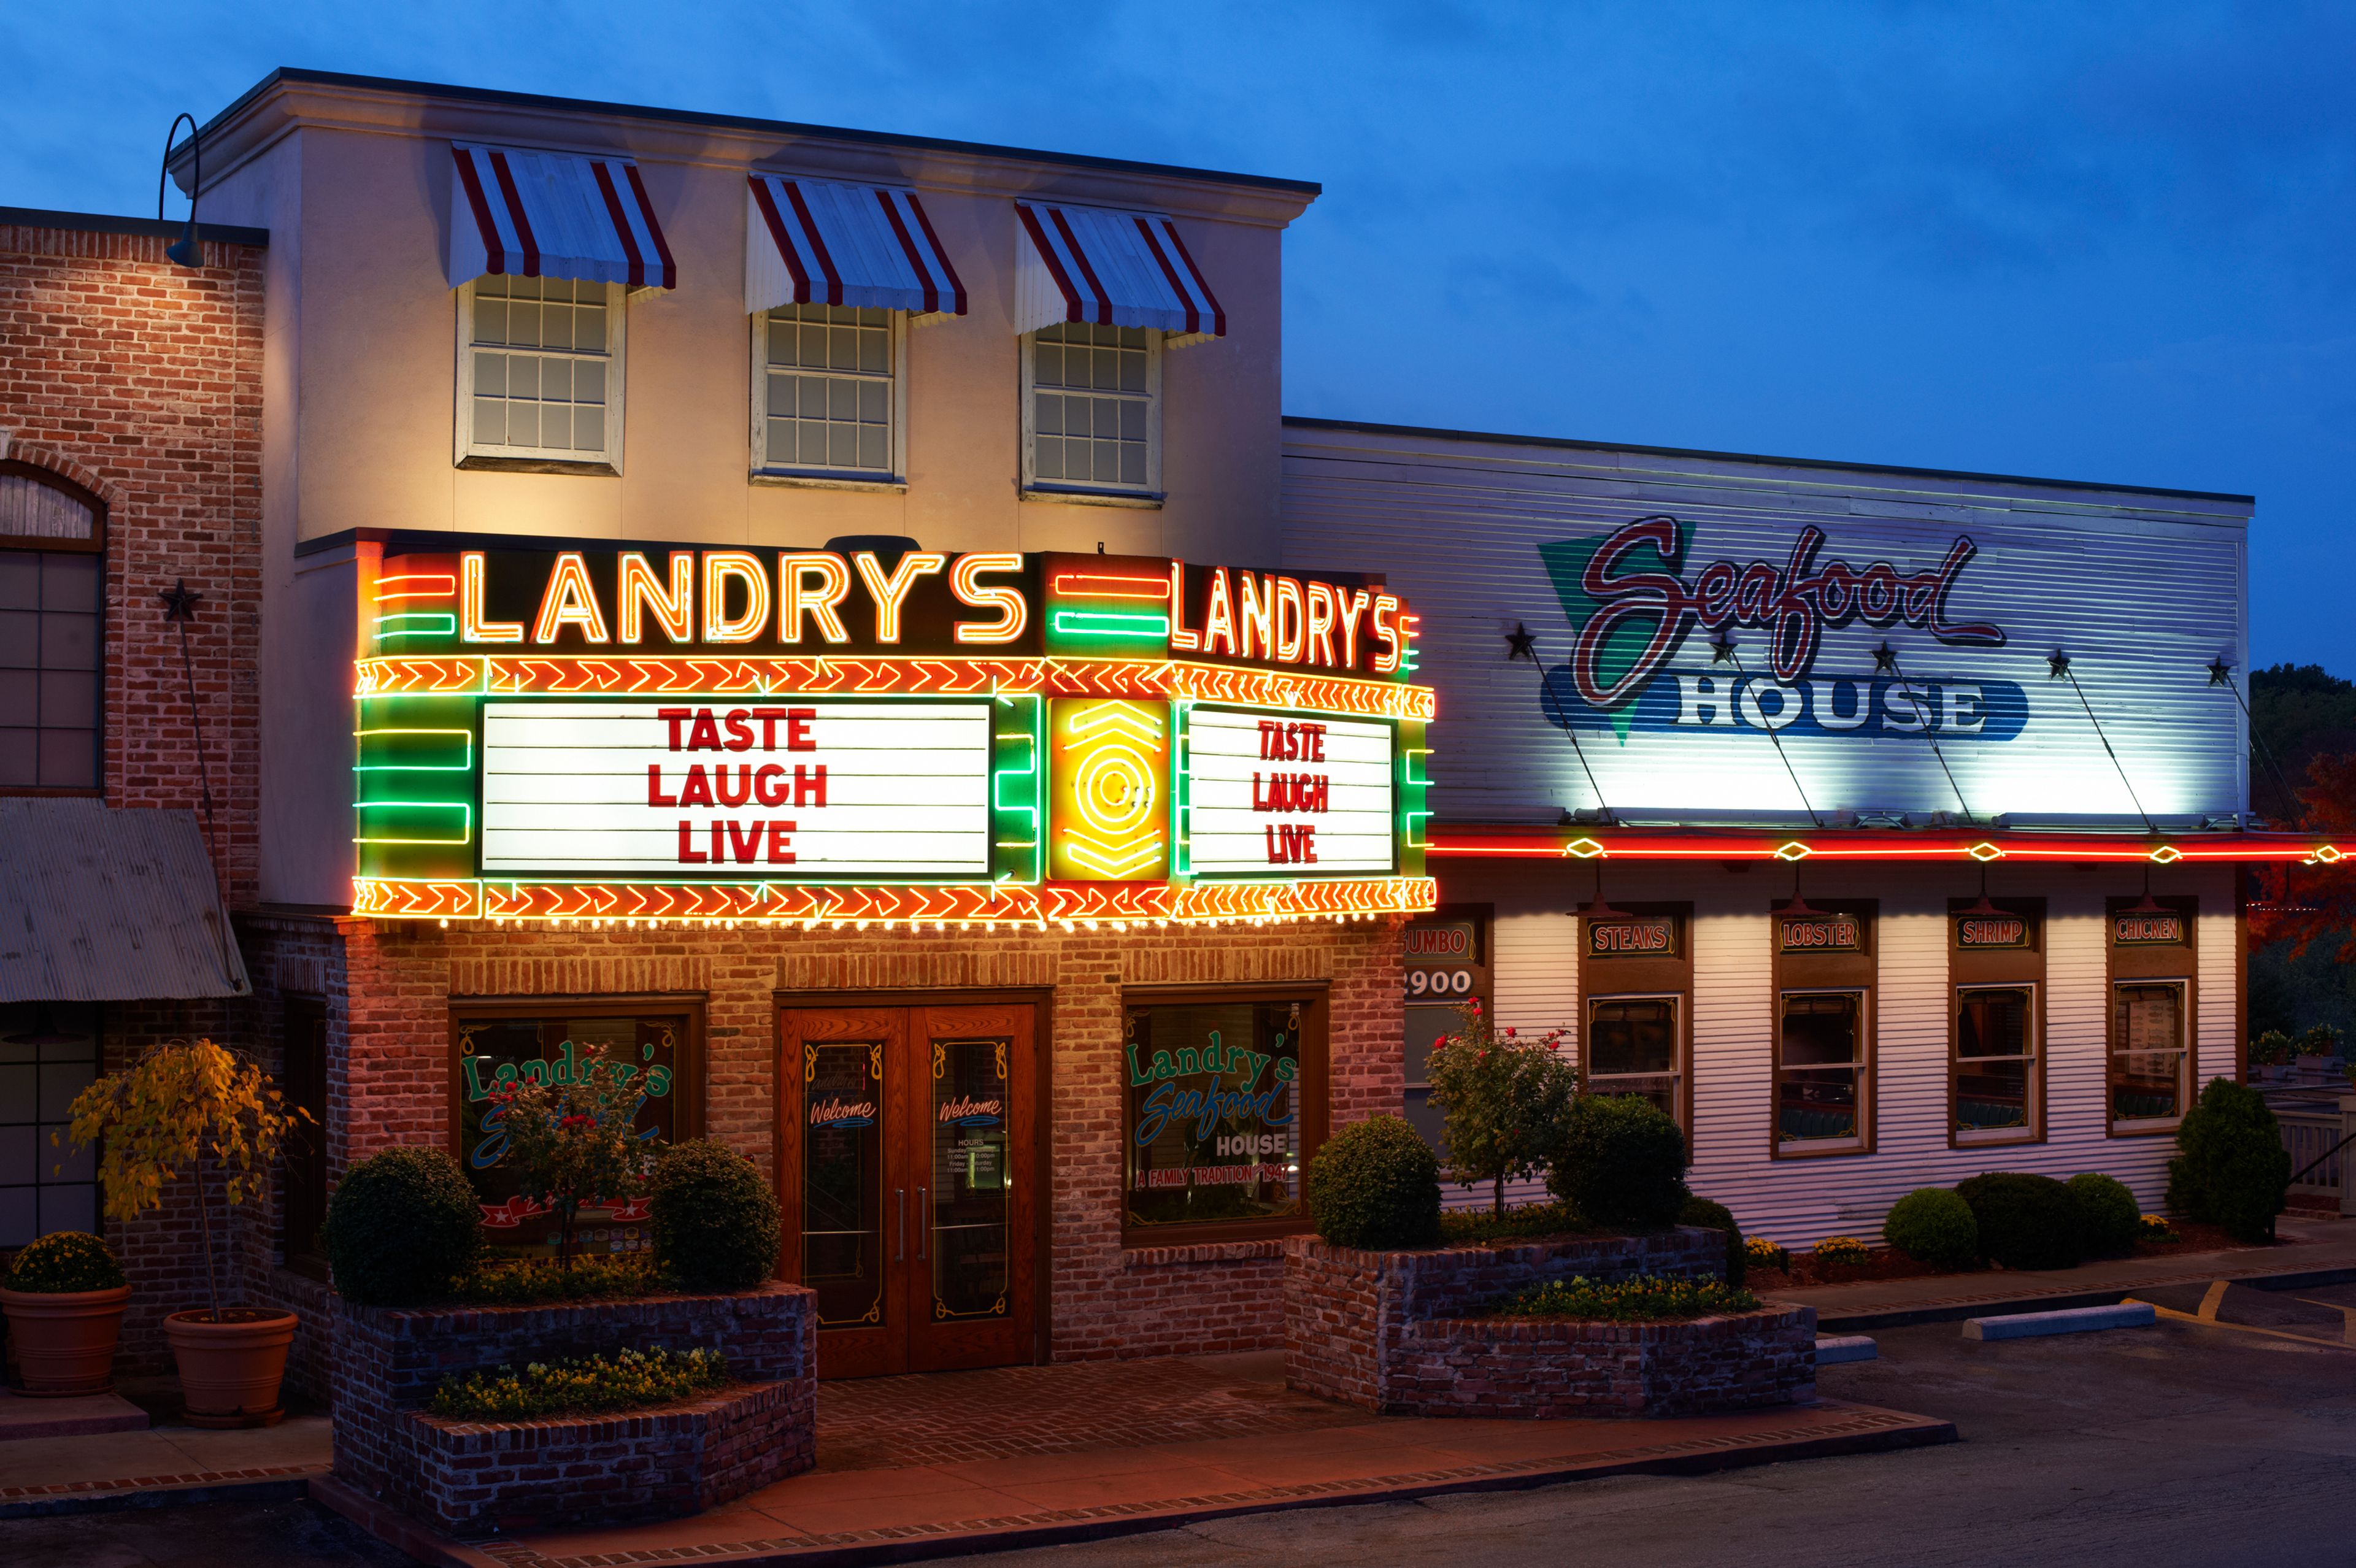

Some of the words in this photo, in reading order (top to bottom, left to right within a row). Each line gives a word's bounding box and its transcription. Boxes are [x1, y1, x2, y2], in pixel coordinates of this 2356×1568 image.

[1571, 515, 2007, 712] Seafood
[1671, 674, 1988, 733] HOUSE
[658, 707, 816, 753] TASTE
[1257, 720, 1326, 763] TASTE
[648, 764, 828, 809] LAUGH
[1252, 772, 1328, 813] LAUGH
[677, 820, 797, 865] LIVE
[1266, 824, 1318, 864] LIVE
[1595, 925, 1667, 950] STEAKS
[1783, 923, 1855, 947] LOBSTER
[1963, 919, 2023, 943] SHRIMP
[2116, 917, 2177, 940] CHICKEN
[461, 1040, 672, 1104] Landry's
[1126, 1030, 1297, 1092] Landry's
[810, 1097, 877, 1124] Welcome
[940, 1095, 1003, 1122] Welcome
[1135, 1075, 1295, 1147] Seafood
[1217, 1133, 1287, 1156] HOUSE
[1135, 1170, 1147, 1188] A
[1149, 1167, 1191, 1188] FAMILY
[1193, 1164, 1253, 1186] TRADITION
[1263, 1163, 1290, 1182] 1947
